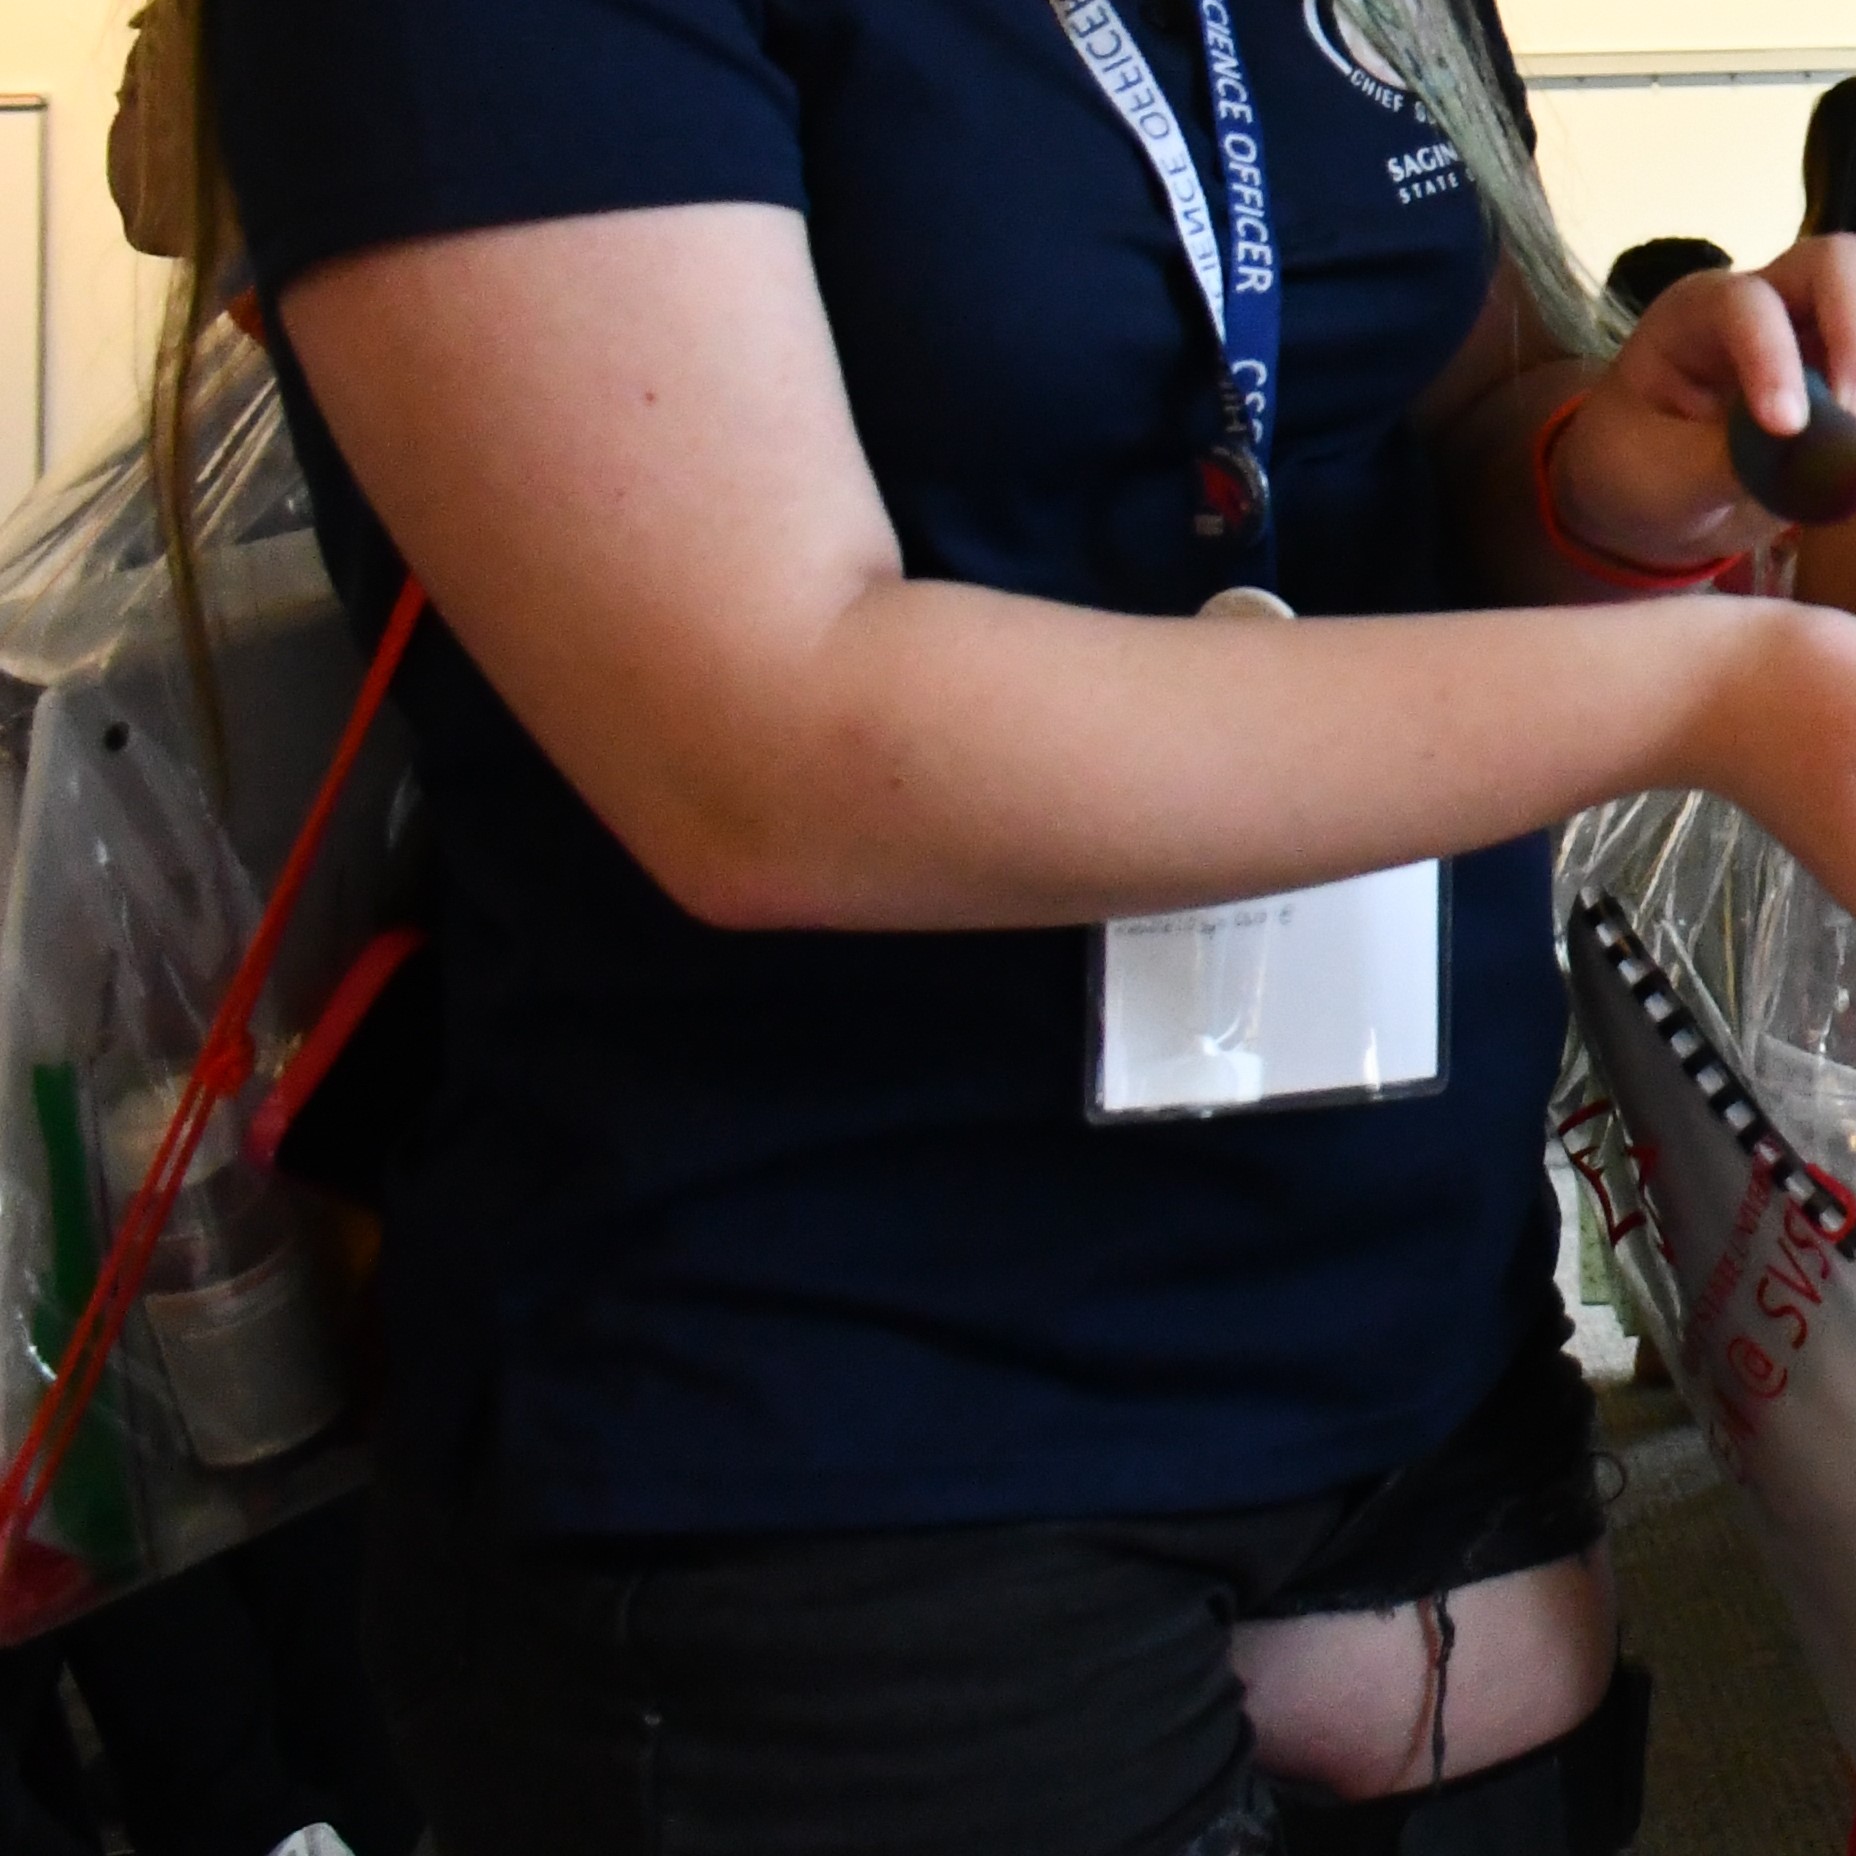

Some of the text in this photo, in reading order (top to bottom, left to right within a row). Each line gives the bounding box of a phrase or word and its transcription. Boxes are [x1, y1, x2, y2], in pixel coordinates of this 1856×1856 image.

[1351, 67, 1405, 114] CHIEF
[1387, 141, 1460, 185] SAGIN
[1398, 171, 1460, 206] STATE
[1222, 132, 1273, 294] OFFICER
